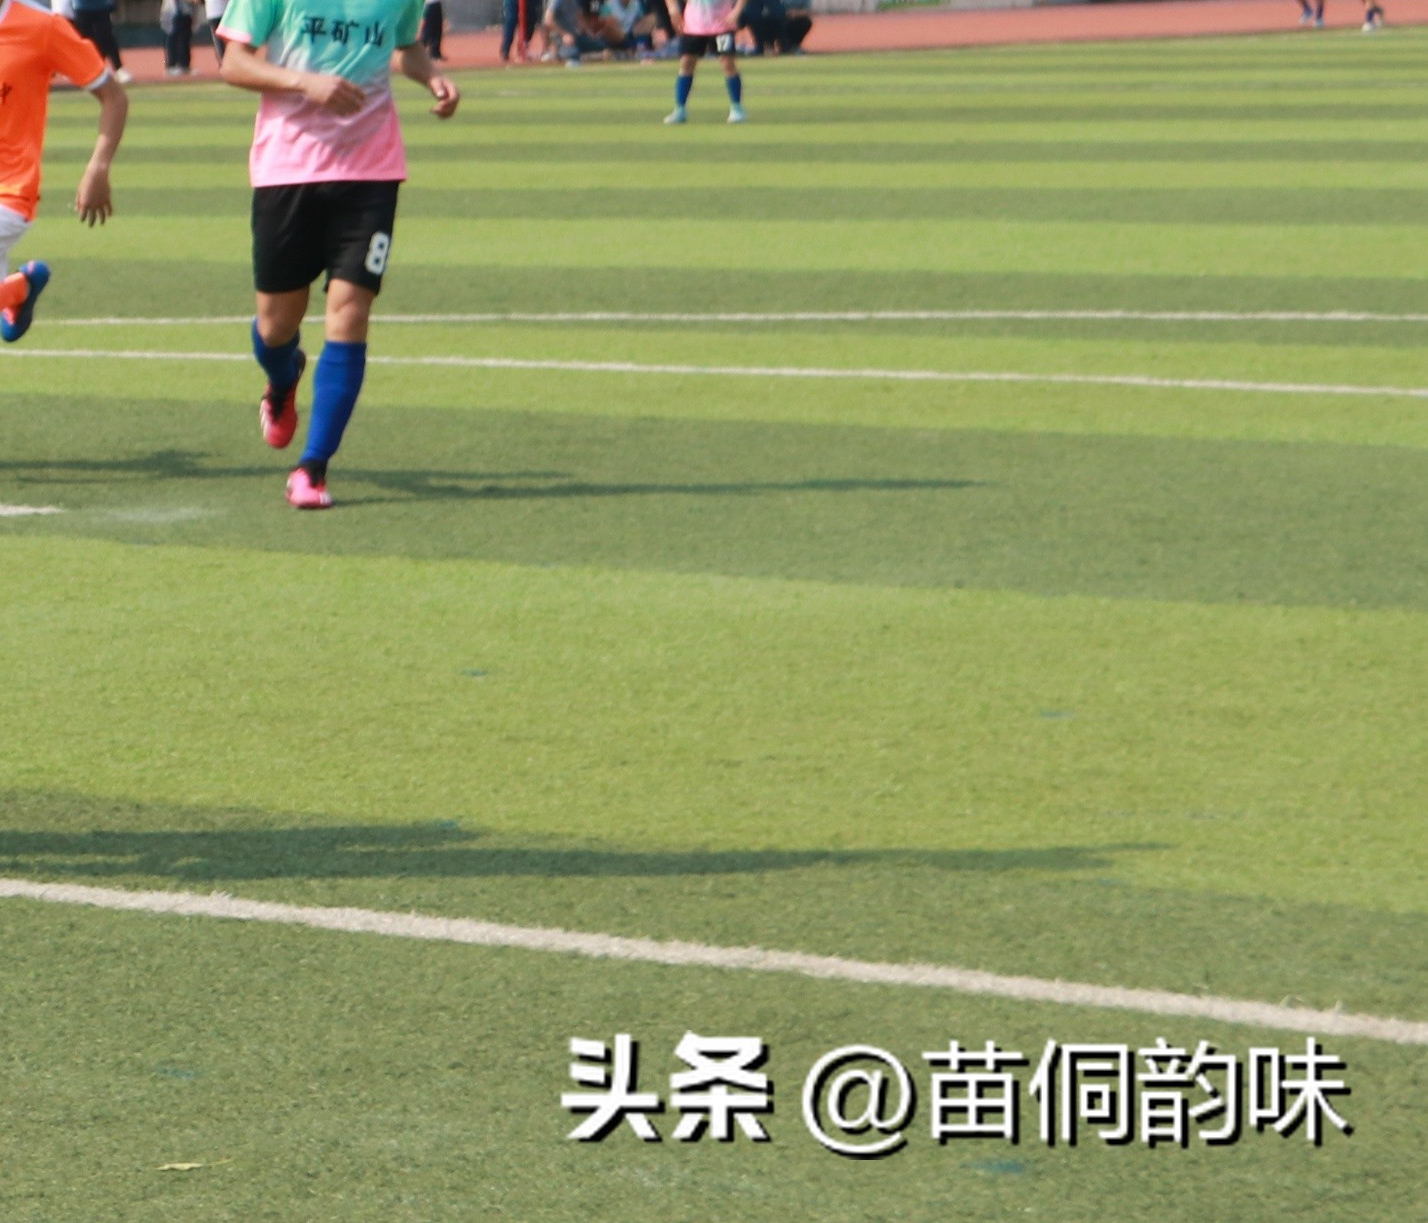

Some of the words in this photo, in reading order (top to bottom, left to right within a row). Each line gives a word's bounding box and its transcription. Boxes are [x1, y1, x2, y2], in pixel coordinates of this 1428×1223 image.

[301, 16, 383, 47] 平矿山
[364, 232, 391, 276] 8
